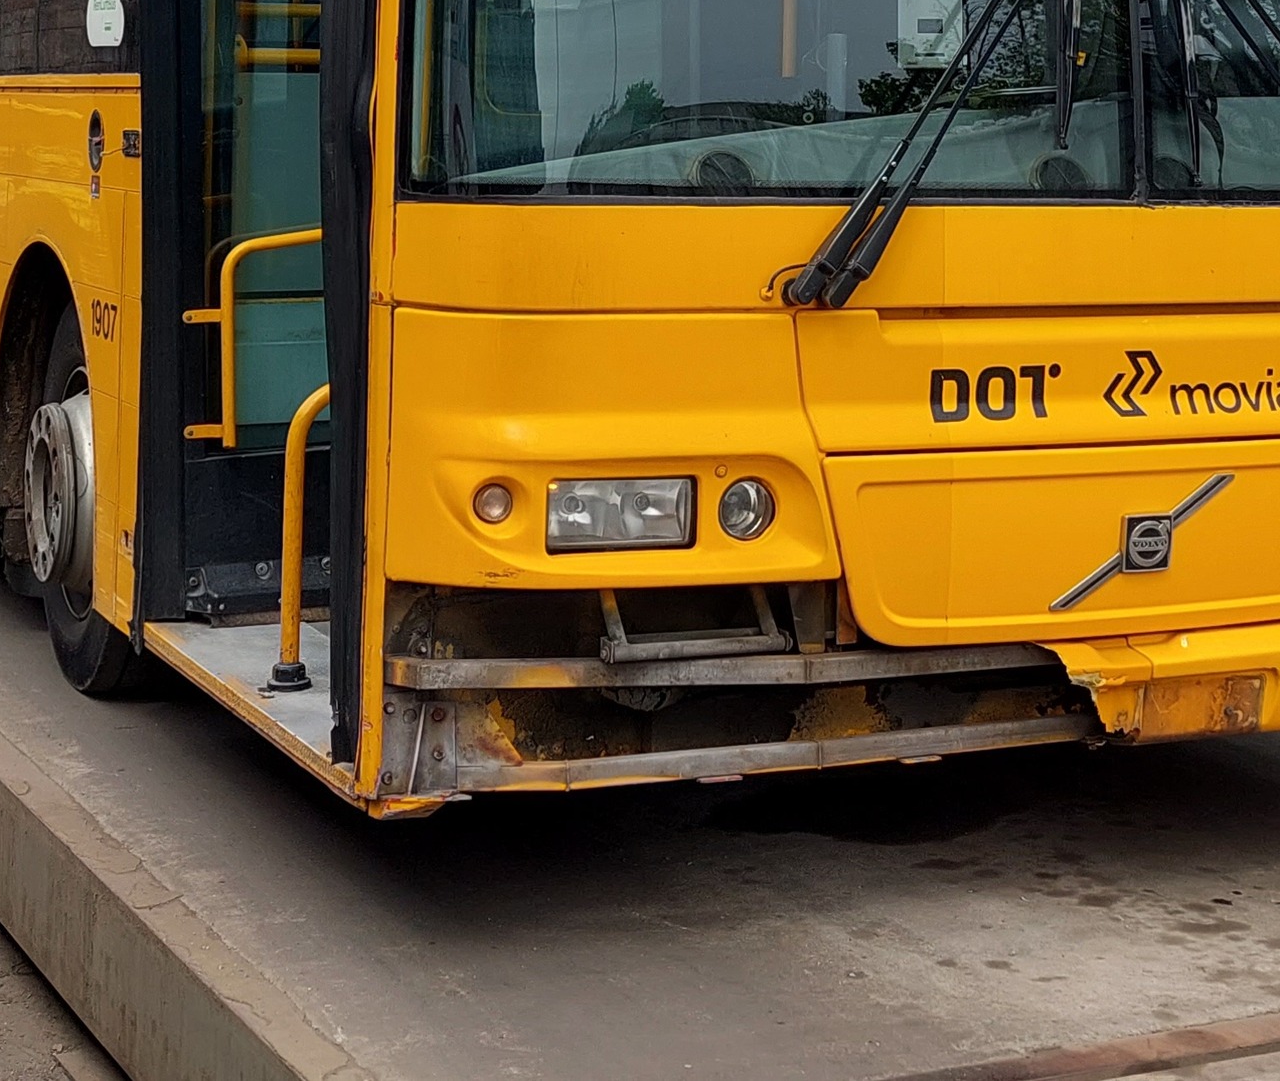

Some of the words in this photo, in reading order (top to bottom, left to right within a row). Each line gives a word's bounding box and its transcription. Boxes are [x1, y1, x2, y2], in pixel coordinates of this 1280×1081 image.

[91, 299, 118, 342] 1907
[930, 363, 1061, 423] DOT
[1132, 540, 1168, 548] VOLVO
